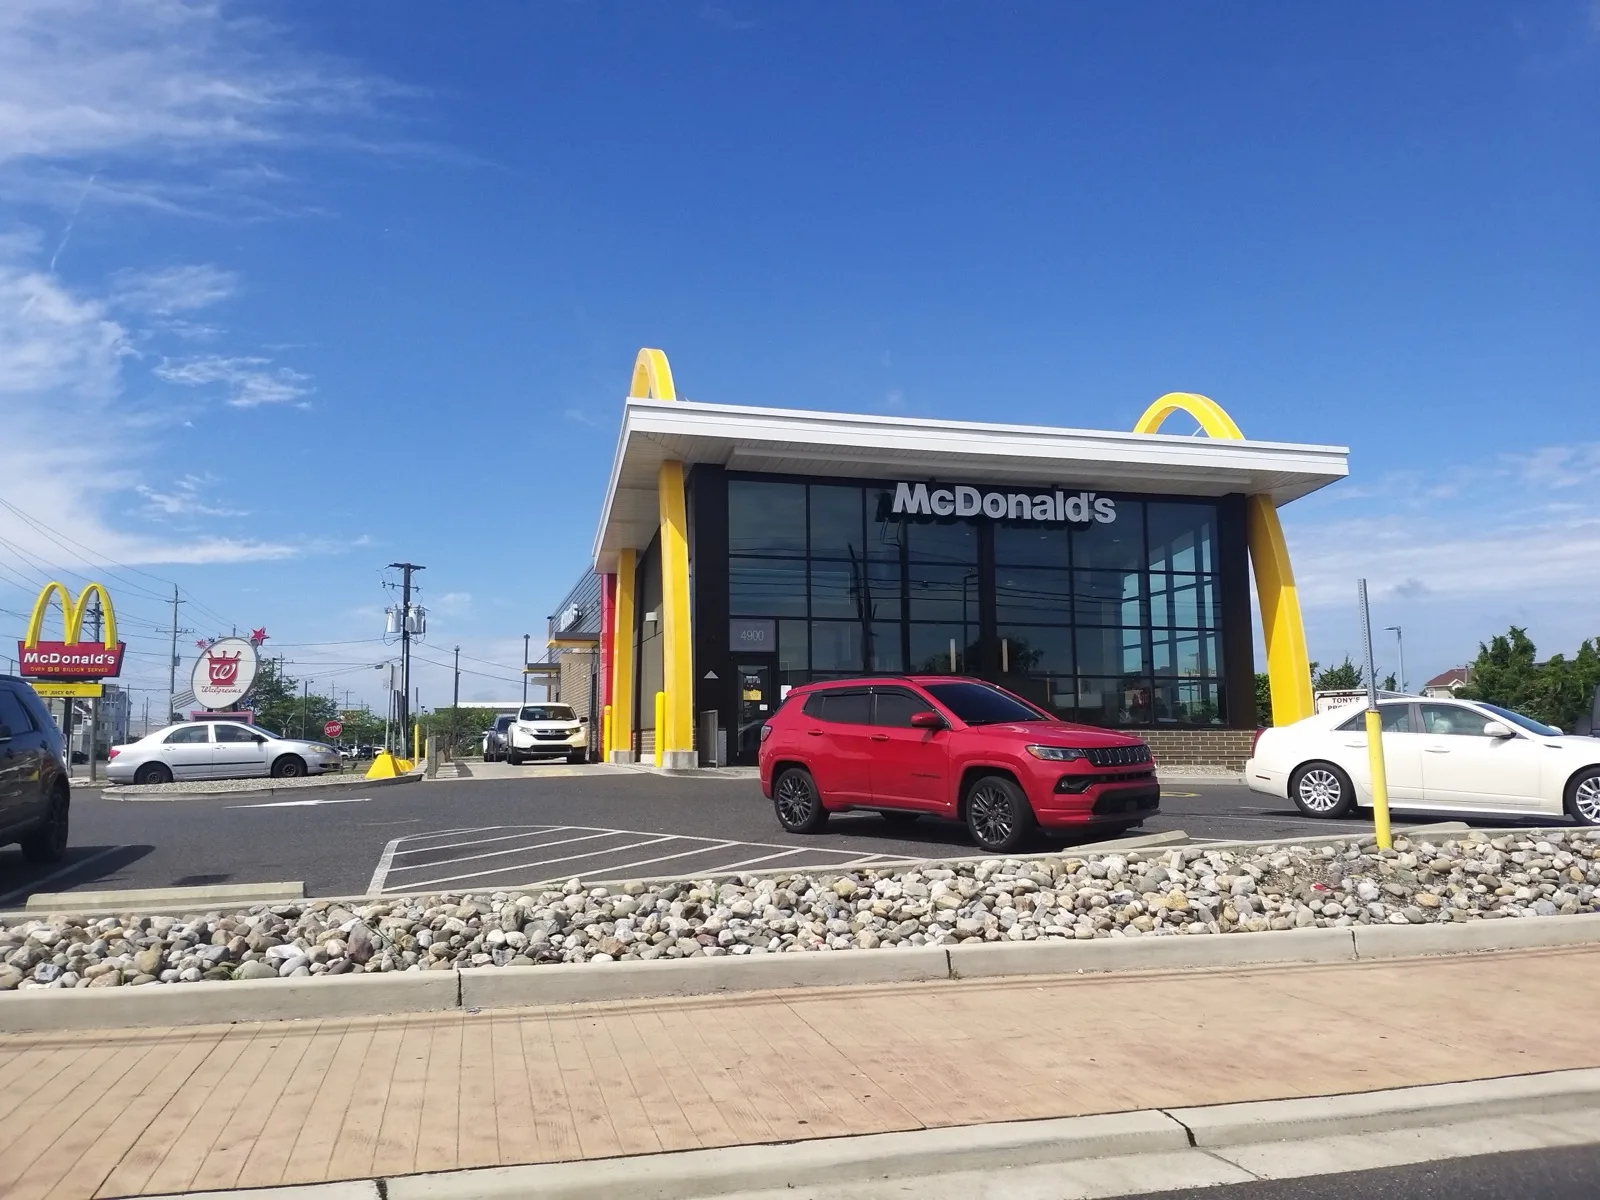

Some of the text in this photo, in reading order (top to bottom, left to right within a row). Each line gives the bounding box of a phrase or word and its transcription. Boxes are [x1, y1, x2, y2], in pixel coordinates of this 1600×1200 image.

[892, 482, 1117, 524] McDonald's
[740, 630, 765, 641] 4900
[24, 652, 115, 665] McDonald's
[201, 686, 242, 695] Walgreens
[326, 725, 341, 734] STOP
